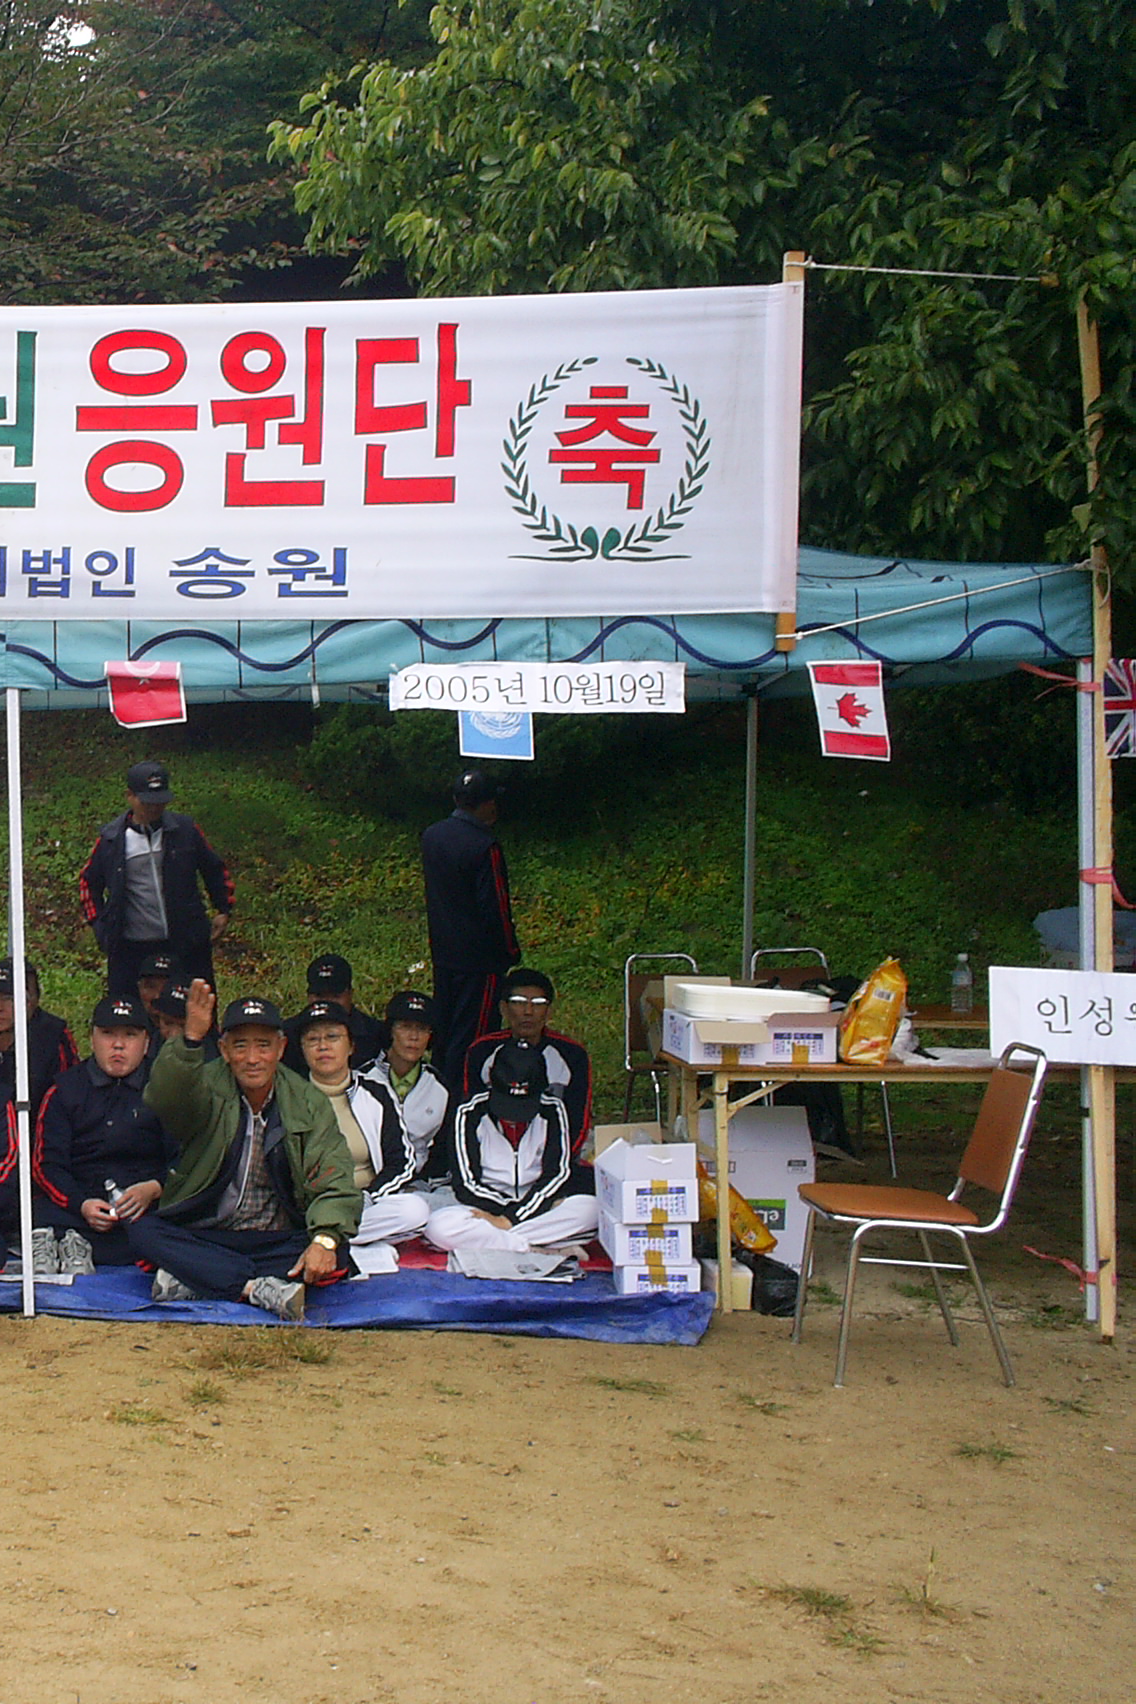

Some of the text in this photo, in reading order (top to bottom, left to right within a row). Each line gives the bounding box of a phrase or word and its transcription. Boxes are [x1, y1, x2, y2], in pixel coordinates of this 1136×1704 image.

[75, 322, 473, 513] 응원단
[548, 385, 661, 510] 축
[167, 547, 350, 600] 송원
[403, 671, 527, 705] 2005년
[1036, 994, 1136, 1037] 인성
